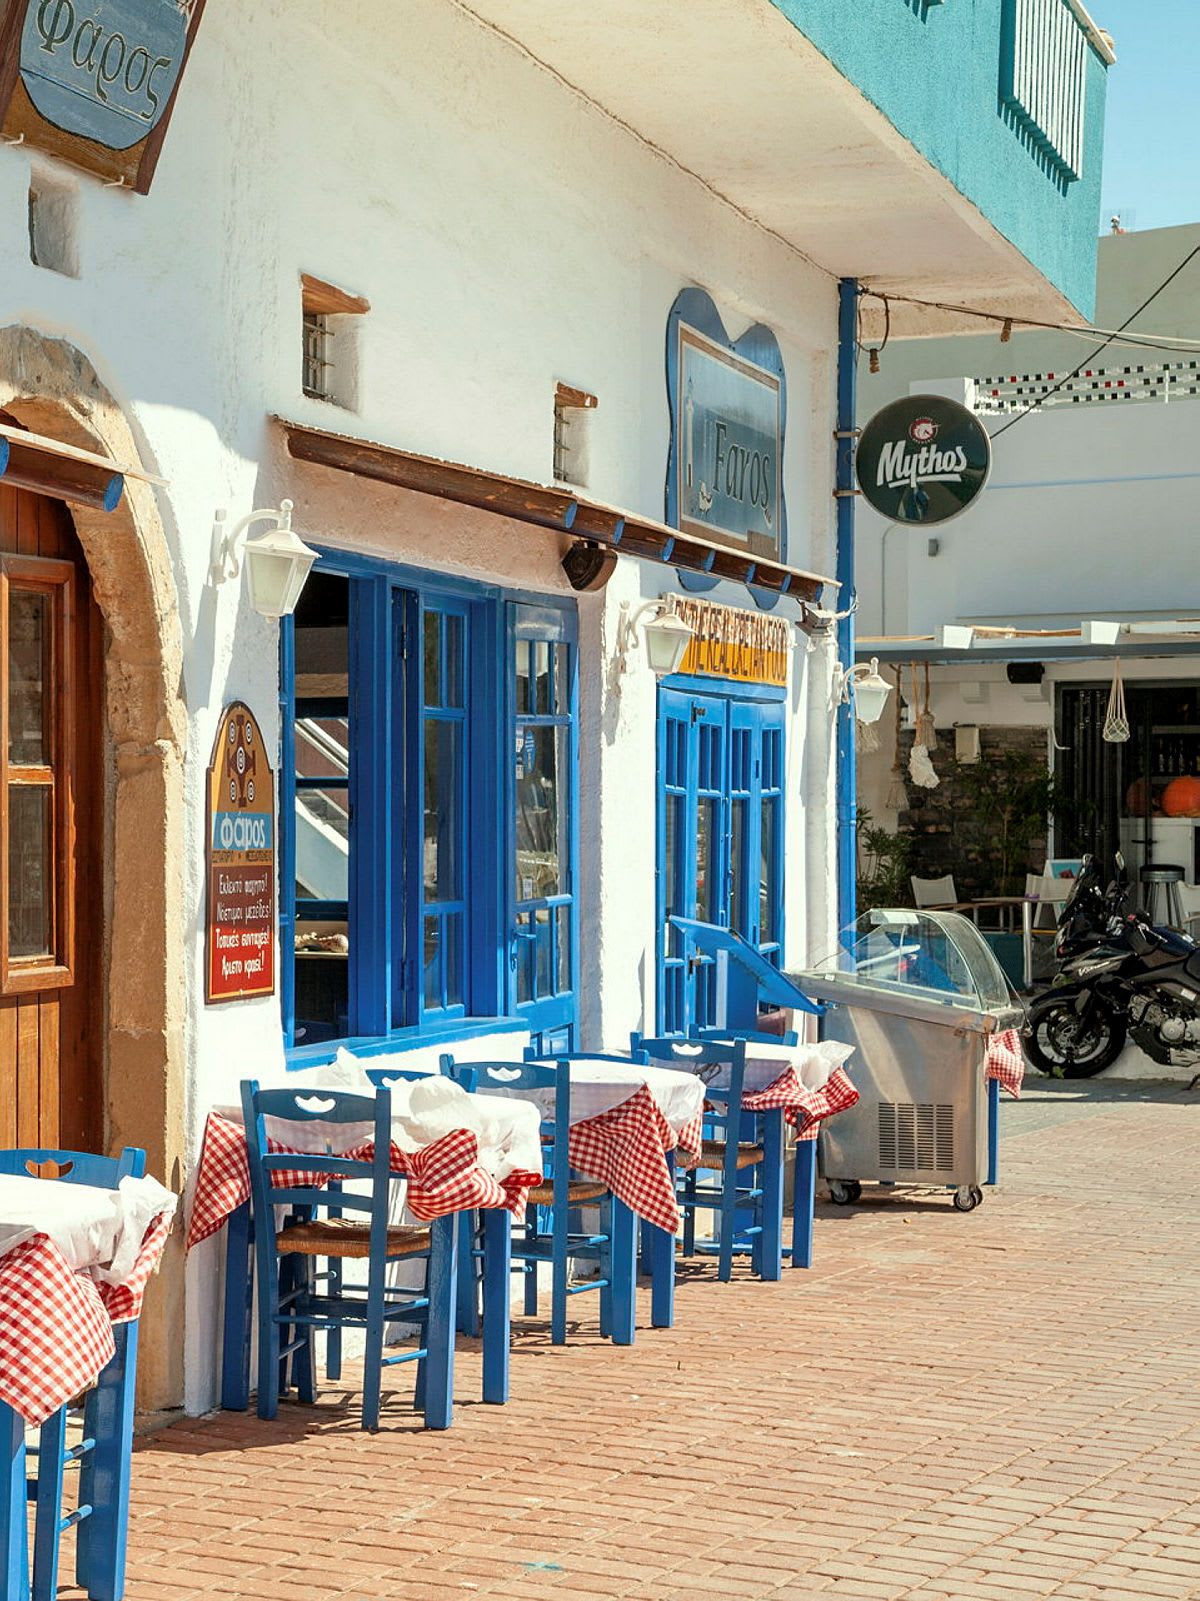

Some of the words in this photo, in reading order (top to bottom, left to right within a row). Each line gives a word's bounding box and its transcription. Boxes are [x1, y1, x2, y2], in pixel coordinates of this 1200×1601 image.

[712, 420, 770, 509] Faros
[875, 440, 967, 488] Mythos
[766, 619, 788, 682] FOOD
